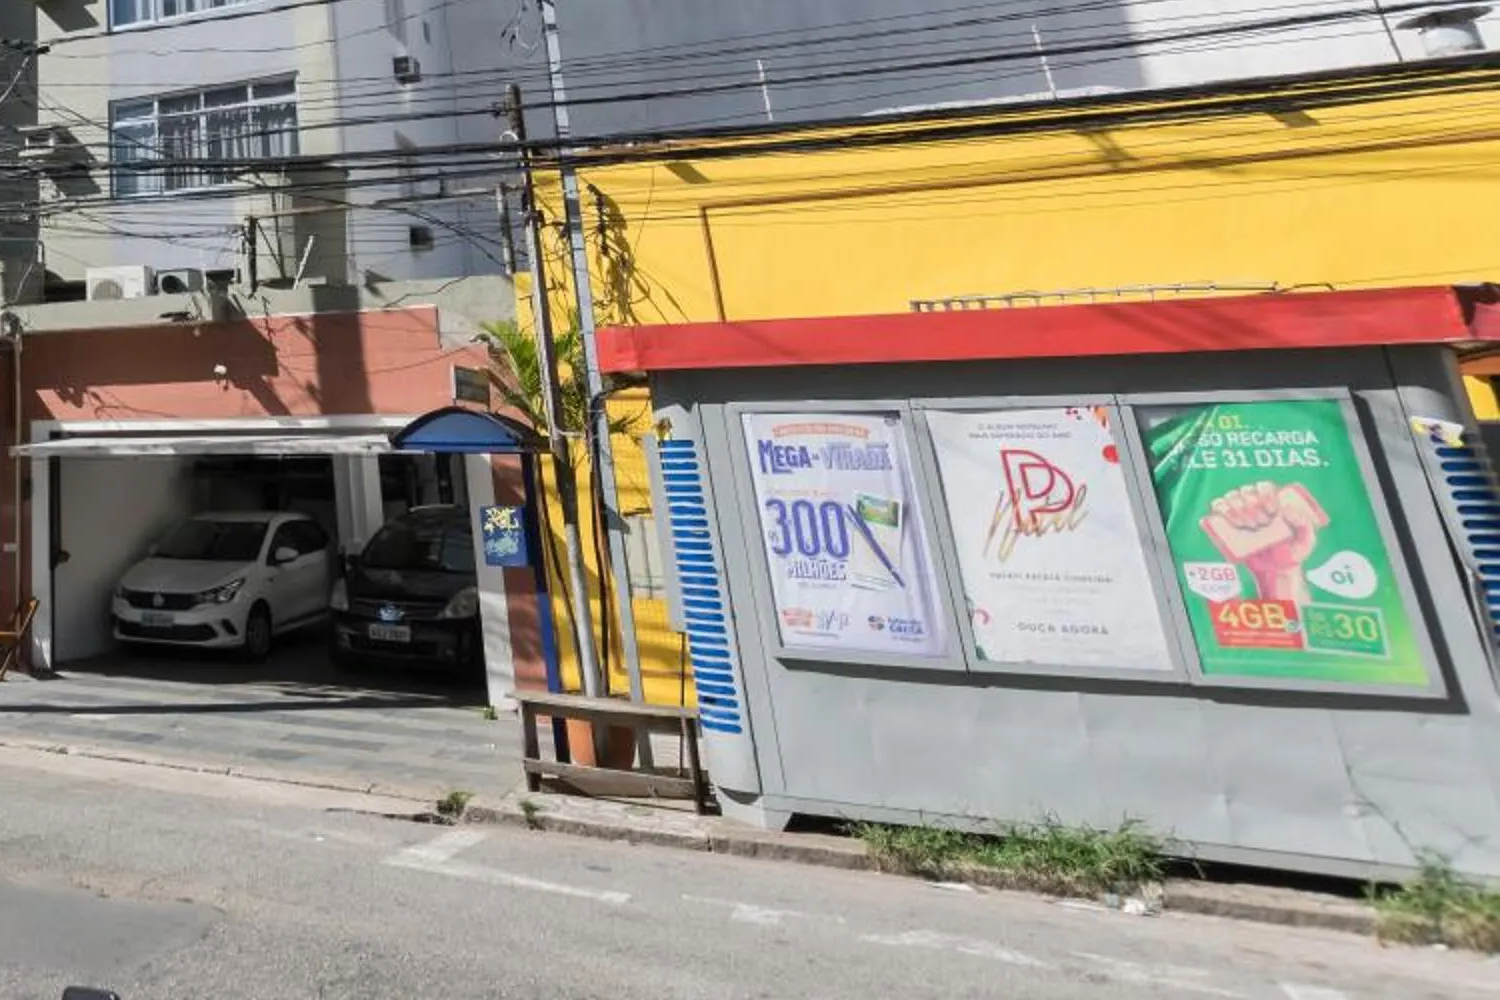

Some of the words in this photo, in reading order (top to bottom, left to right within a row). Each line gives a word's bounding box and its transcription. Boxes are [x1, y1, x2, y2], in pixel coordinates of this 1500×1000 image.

[1228, 430, 1319, 446] RECARGA
[757, 439, 812, 474] MEGA
[1223, 450, 1253, 468] 31
[1255, 448, 1331, 468] DIAS.
[765, 498, 850, 558] 300
[1219, 602, 1285, 630] 4GB
[1334, 613, 1378, 642] 30
